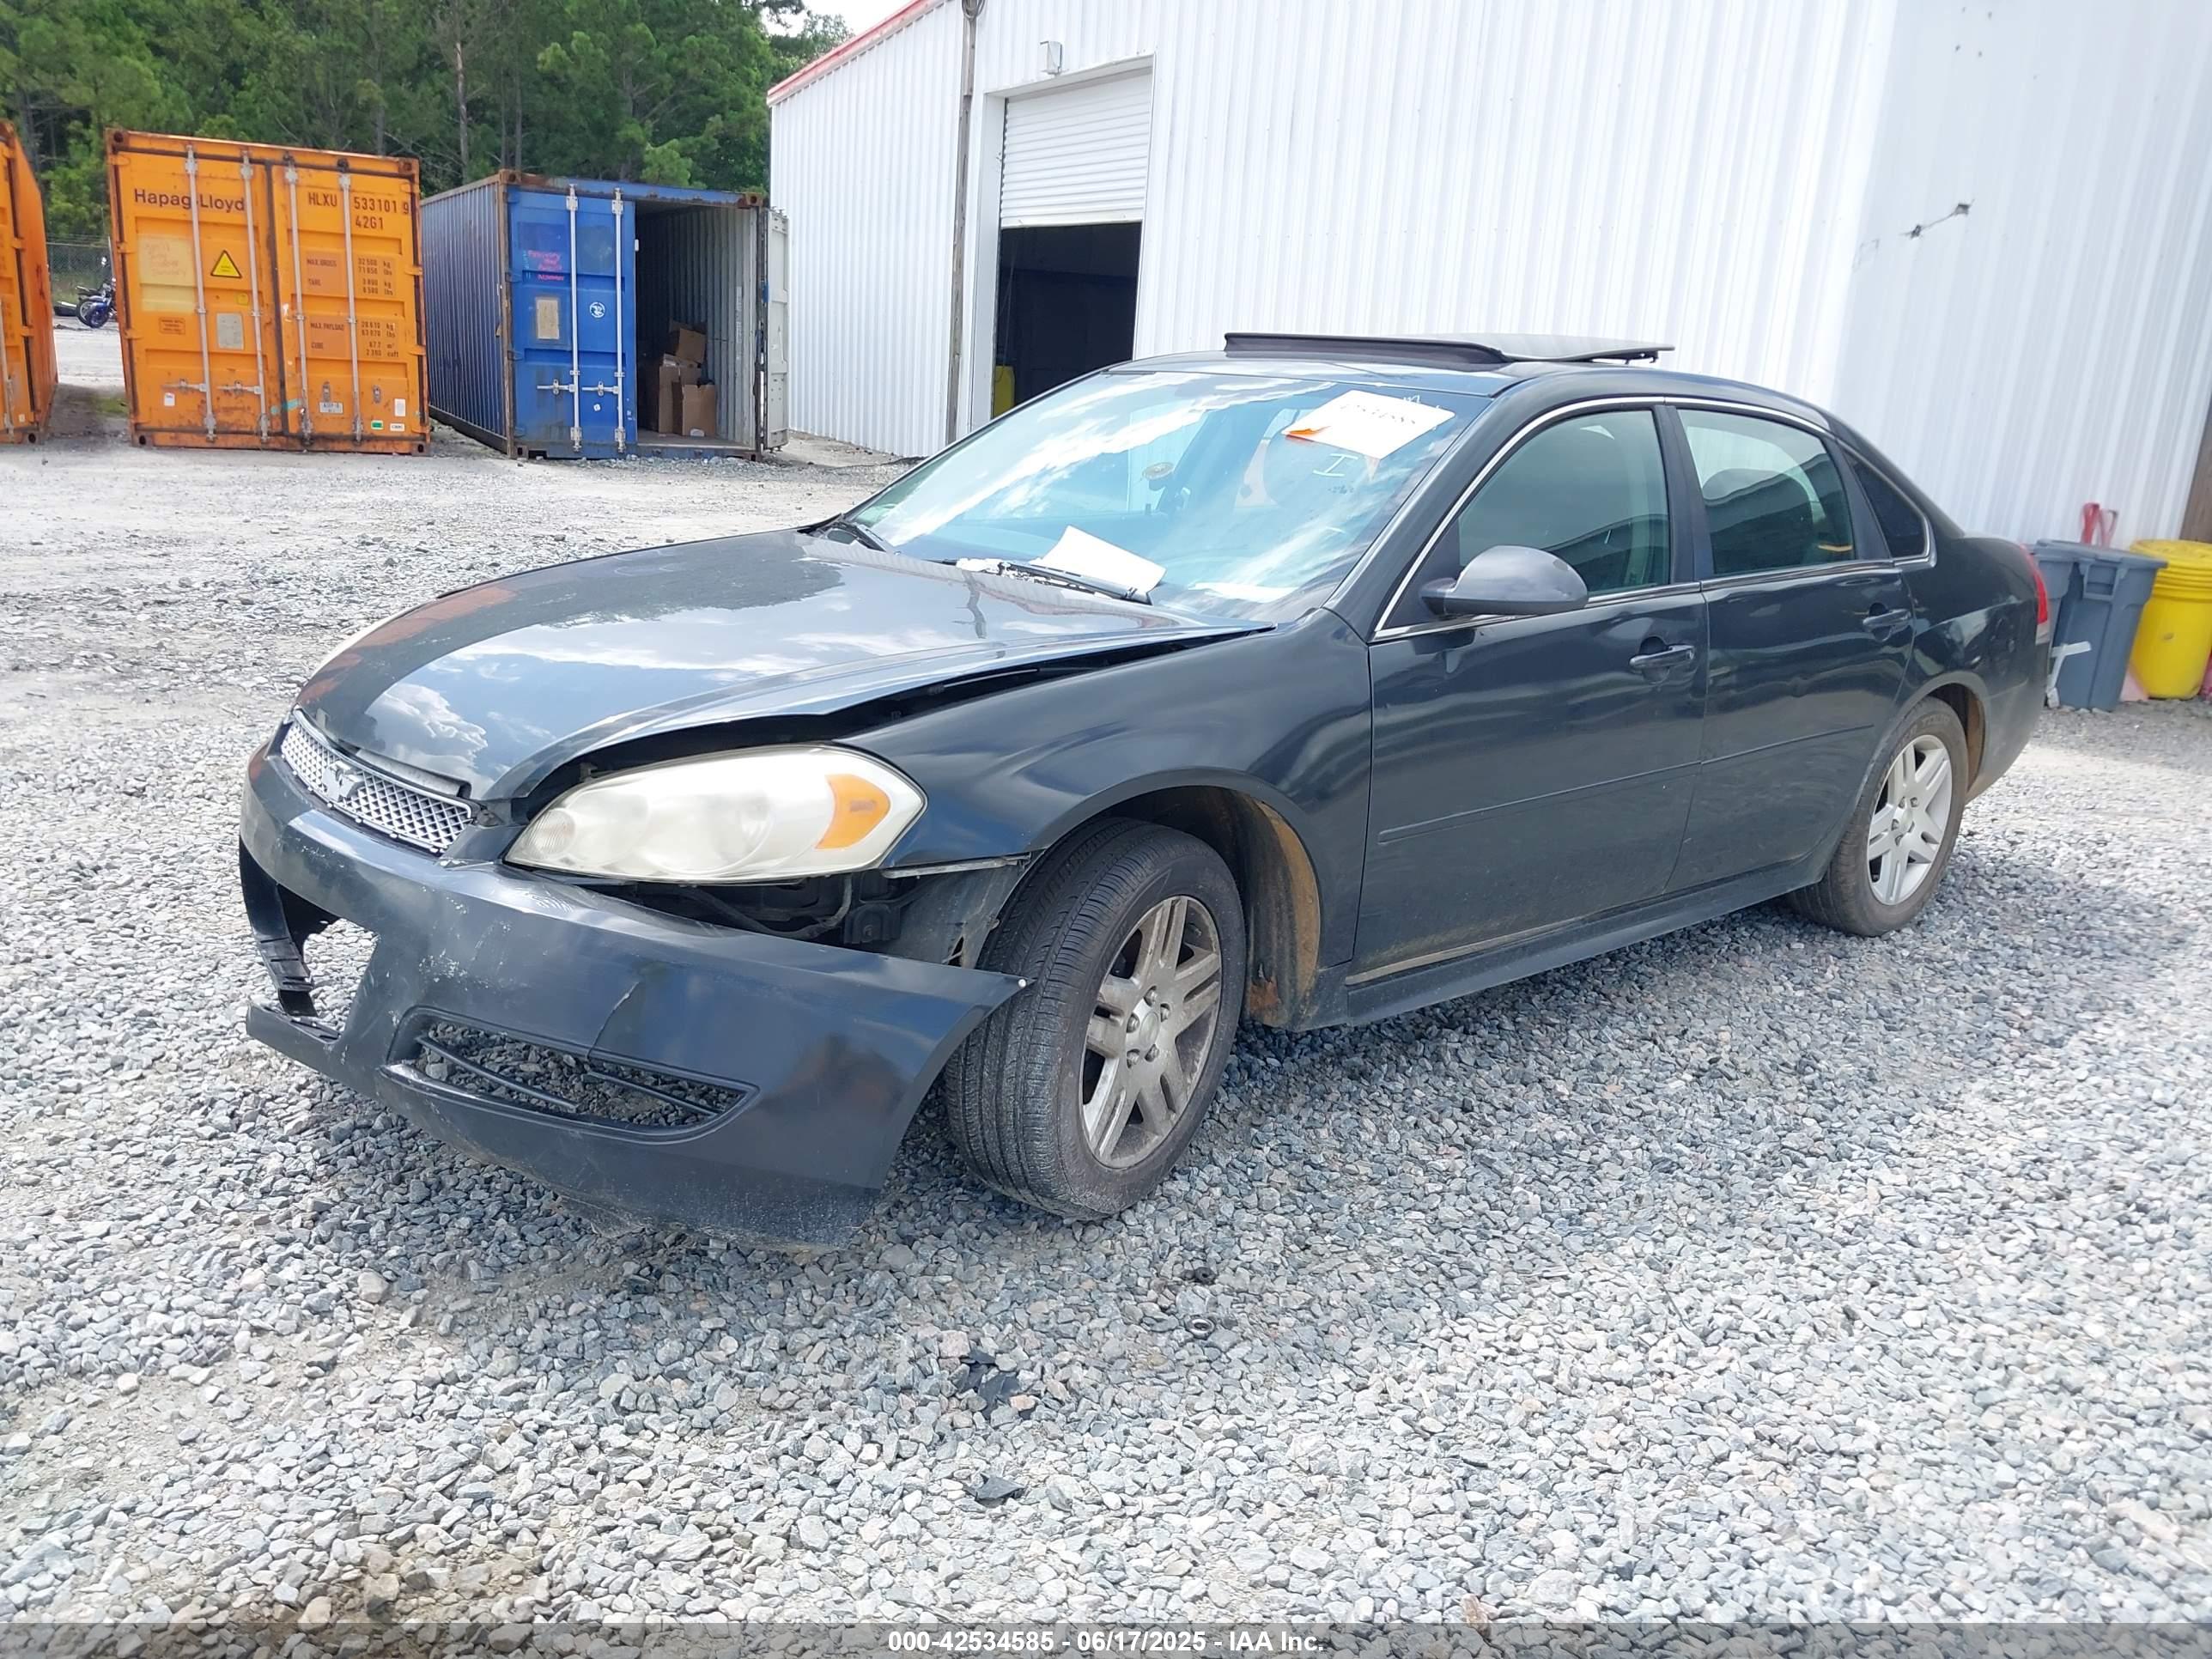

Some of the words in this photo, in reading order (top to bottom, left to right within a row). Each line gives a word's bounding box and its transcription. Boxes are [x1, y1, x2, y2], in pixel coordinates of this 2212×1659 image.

[308, 191, 337, 207] HLXU
[353, 196, 398, 213] 533101
[403, 201, 410, 215] 9
[356, 216, 384, 230] 42G1
